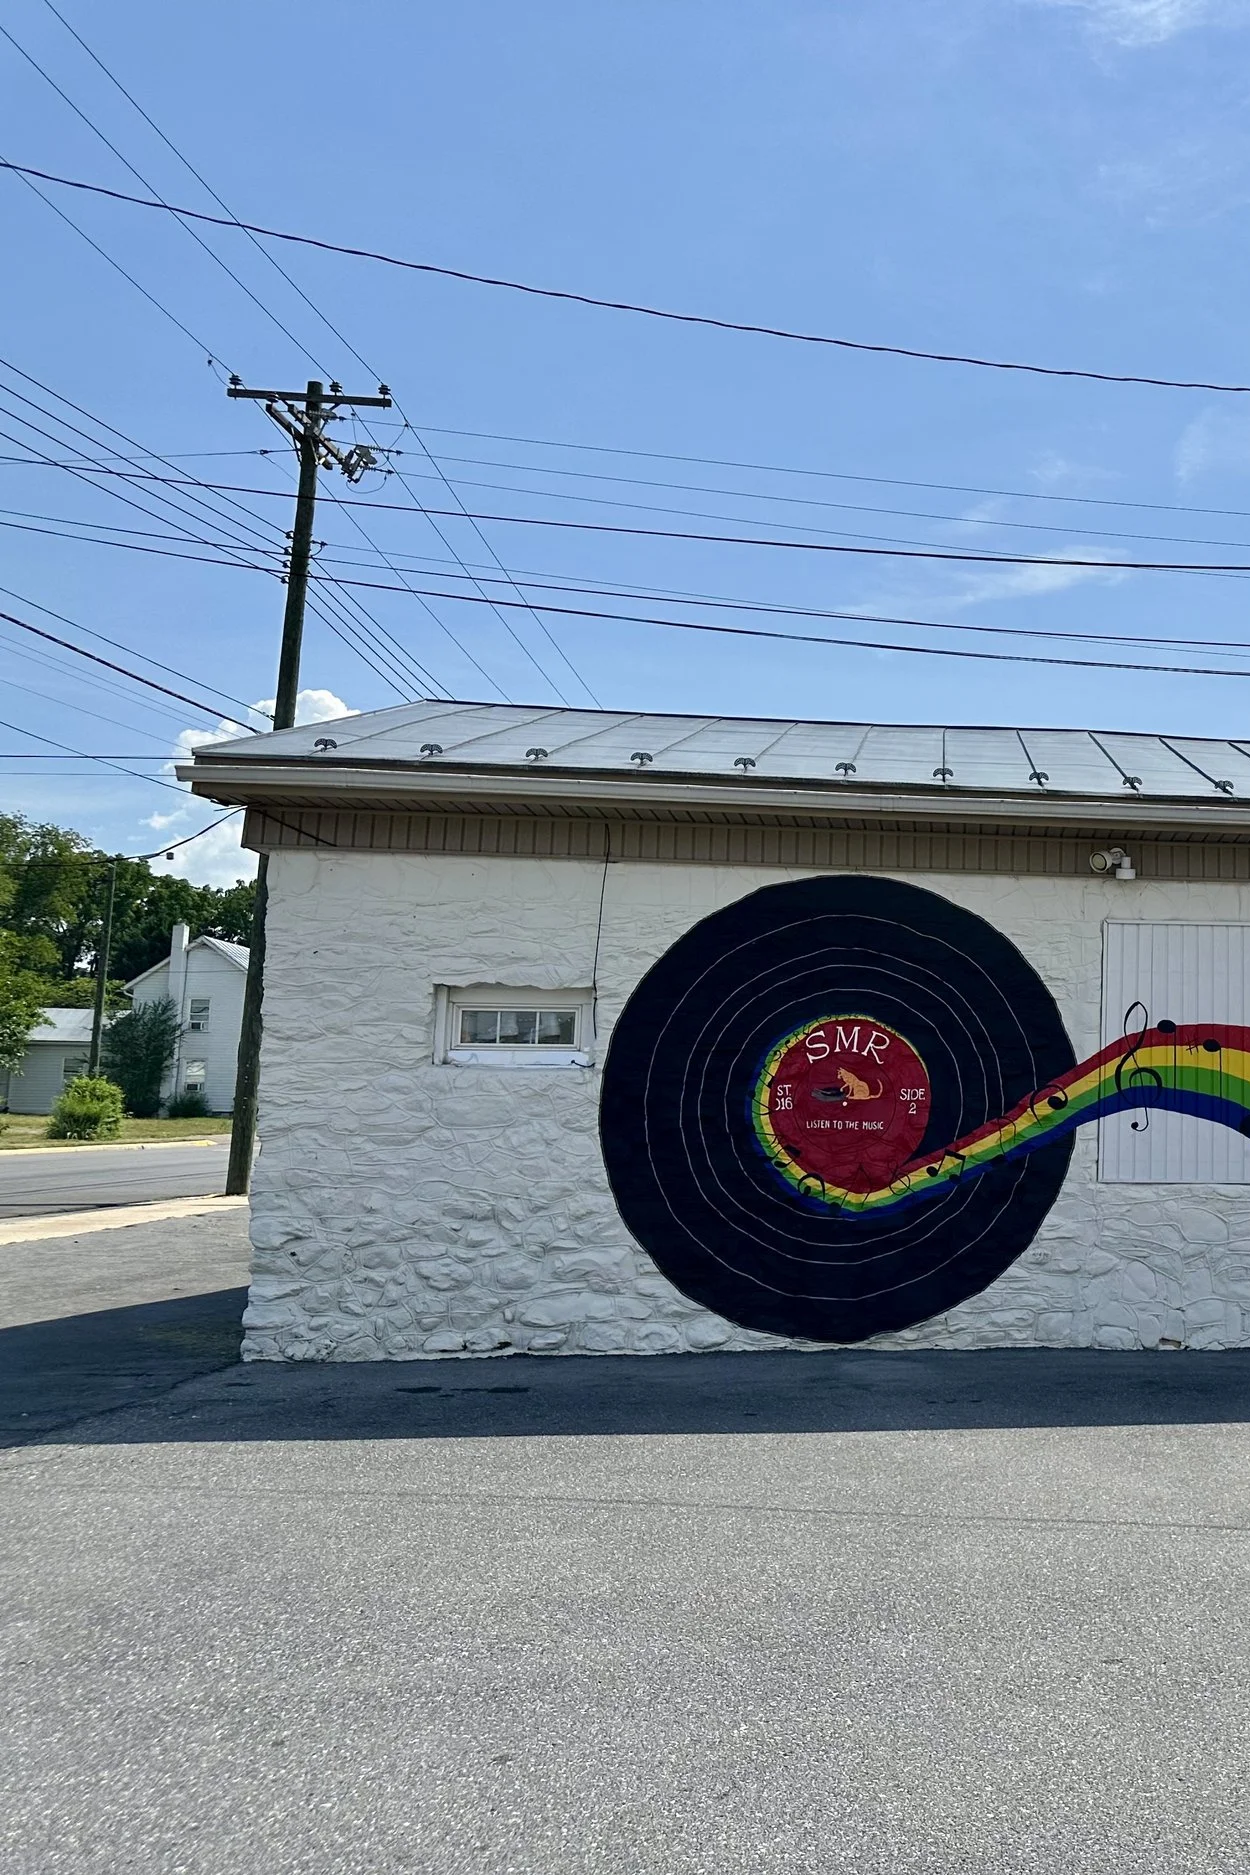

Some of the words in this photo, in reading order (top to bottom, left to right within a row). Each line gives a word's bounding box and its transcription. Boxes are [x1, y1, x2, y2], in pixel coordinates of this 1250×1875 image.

[805, 1026, 890, 1065] SMR
[900, 1088, 926, 1101] SIDE
[908, 1102, 917, 1115] 2
[806, 1119, 830, 1129] LISTEN
[833, 1120, 843, 1130] TO
[845, 1120, 859, 1130] THE
[862, 1121, 884, 1130] MUSIC
